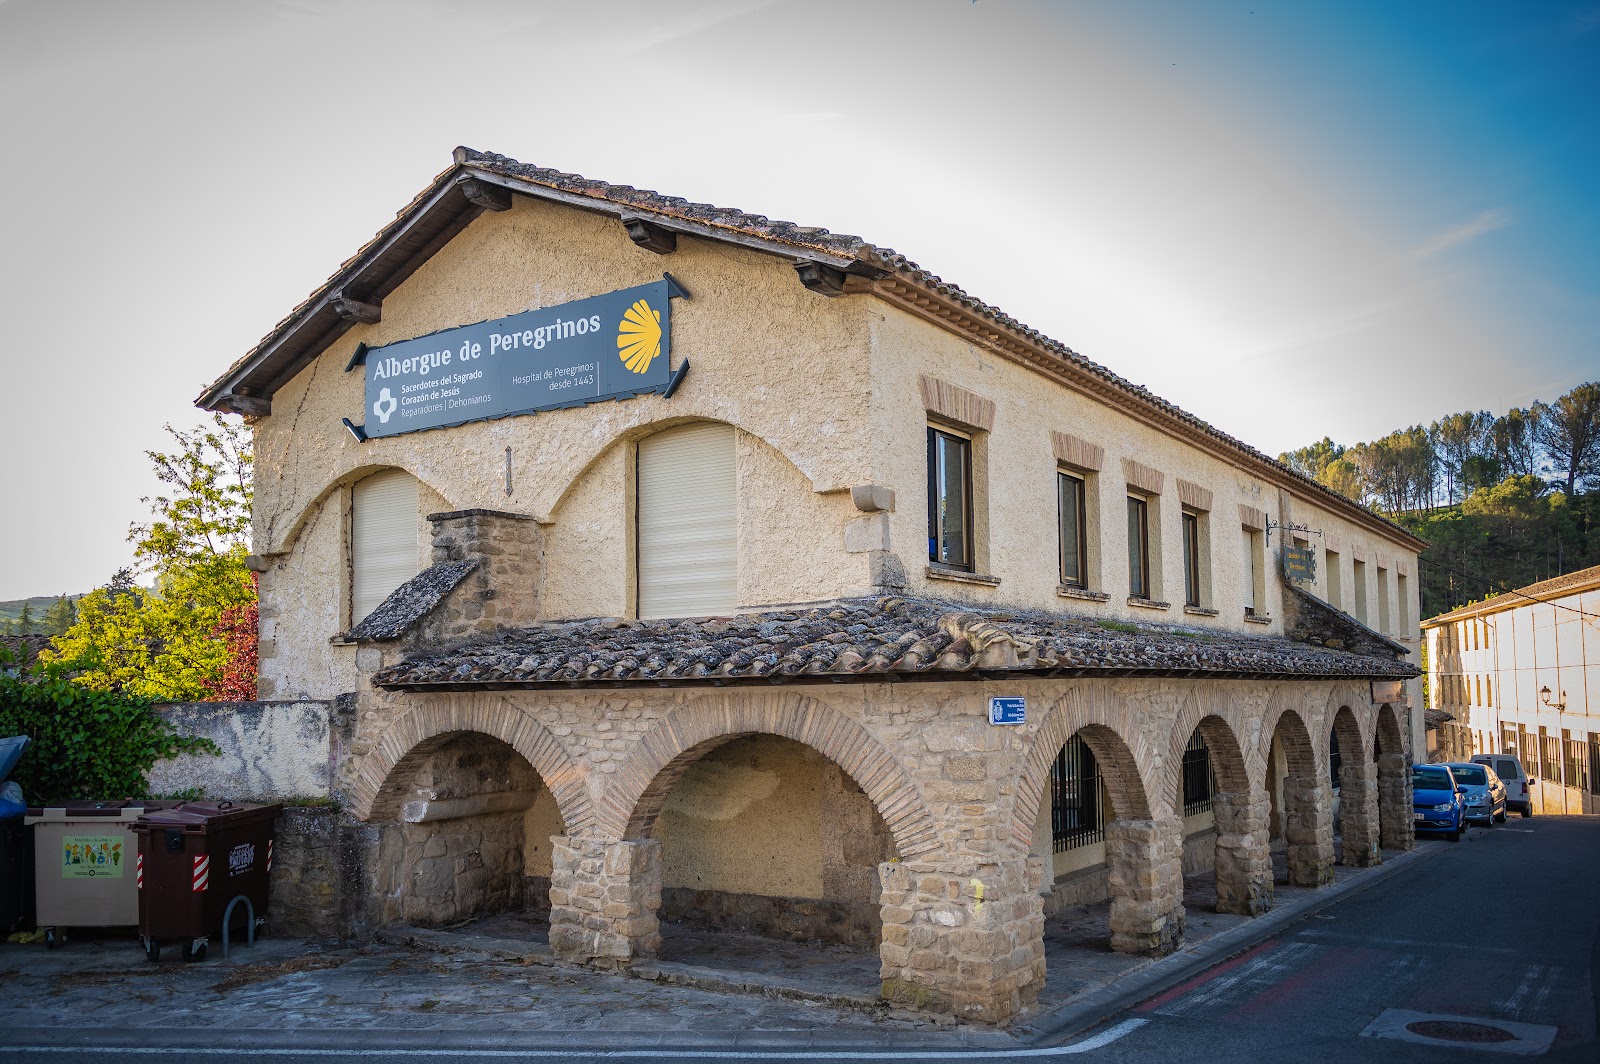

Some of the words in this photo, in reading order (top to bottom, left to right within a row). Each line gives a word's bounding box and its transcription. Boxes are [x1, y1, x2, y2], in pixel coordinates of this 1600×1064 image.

[374, 349, 451, 381] Albergue
[459, 340, 482, 362] de
[489, 315, 601, 356] Peregrinos
[401, 379, 439, 394] Sacerdotes
[440, 376, 452, 386] del
[453, 369, 483, 384] Sagrado
[512, 370, 542, 386] Hospital
[543, 369, 553, 380] de
[554, 362, 594, 377] Peregrinos
[549, 378, 572, 391] desde
[573, 374, 594, 387] 1443
[401, 393, 429, 406] Corazón
[430, 390, 440, 400] de
[440, 386, 460, 398] Jesús
[401, 403, 443, 419] Reparadores
[448, 393, 492, 409] Dehonianos
